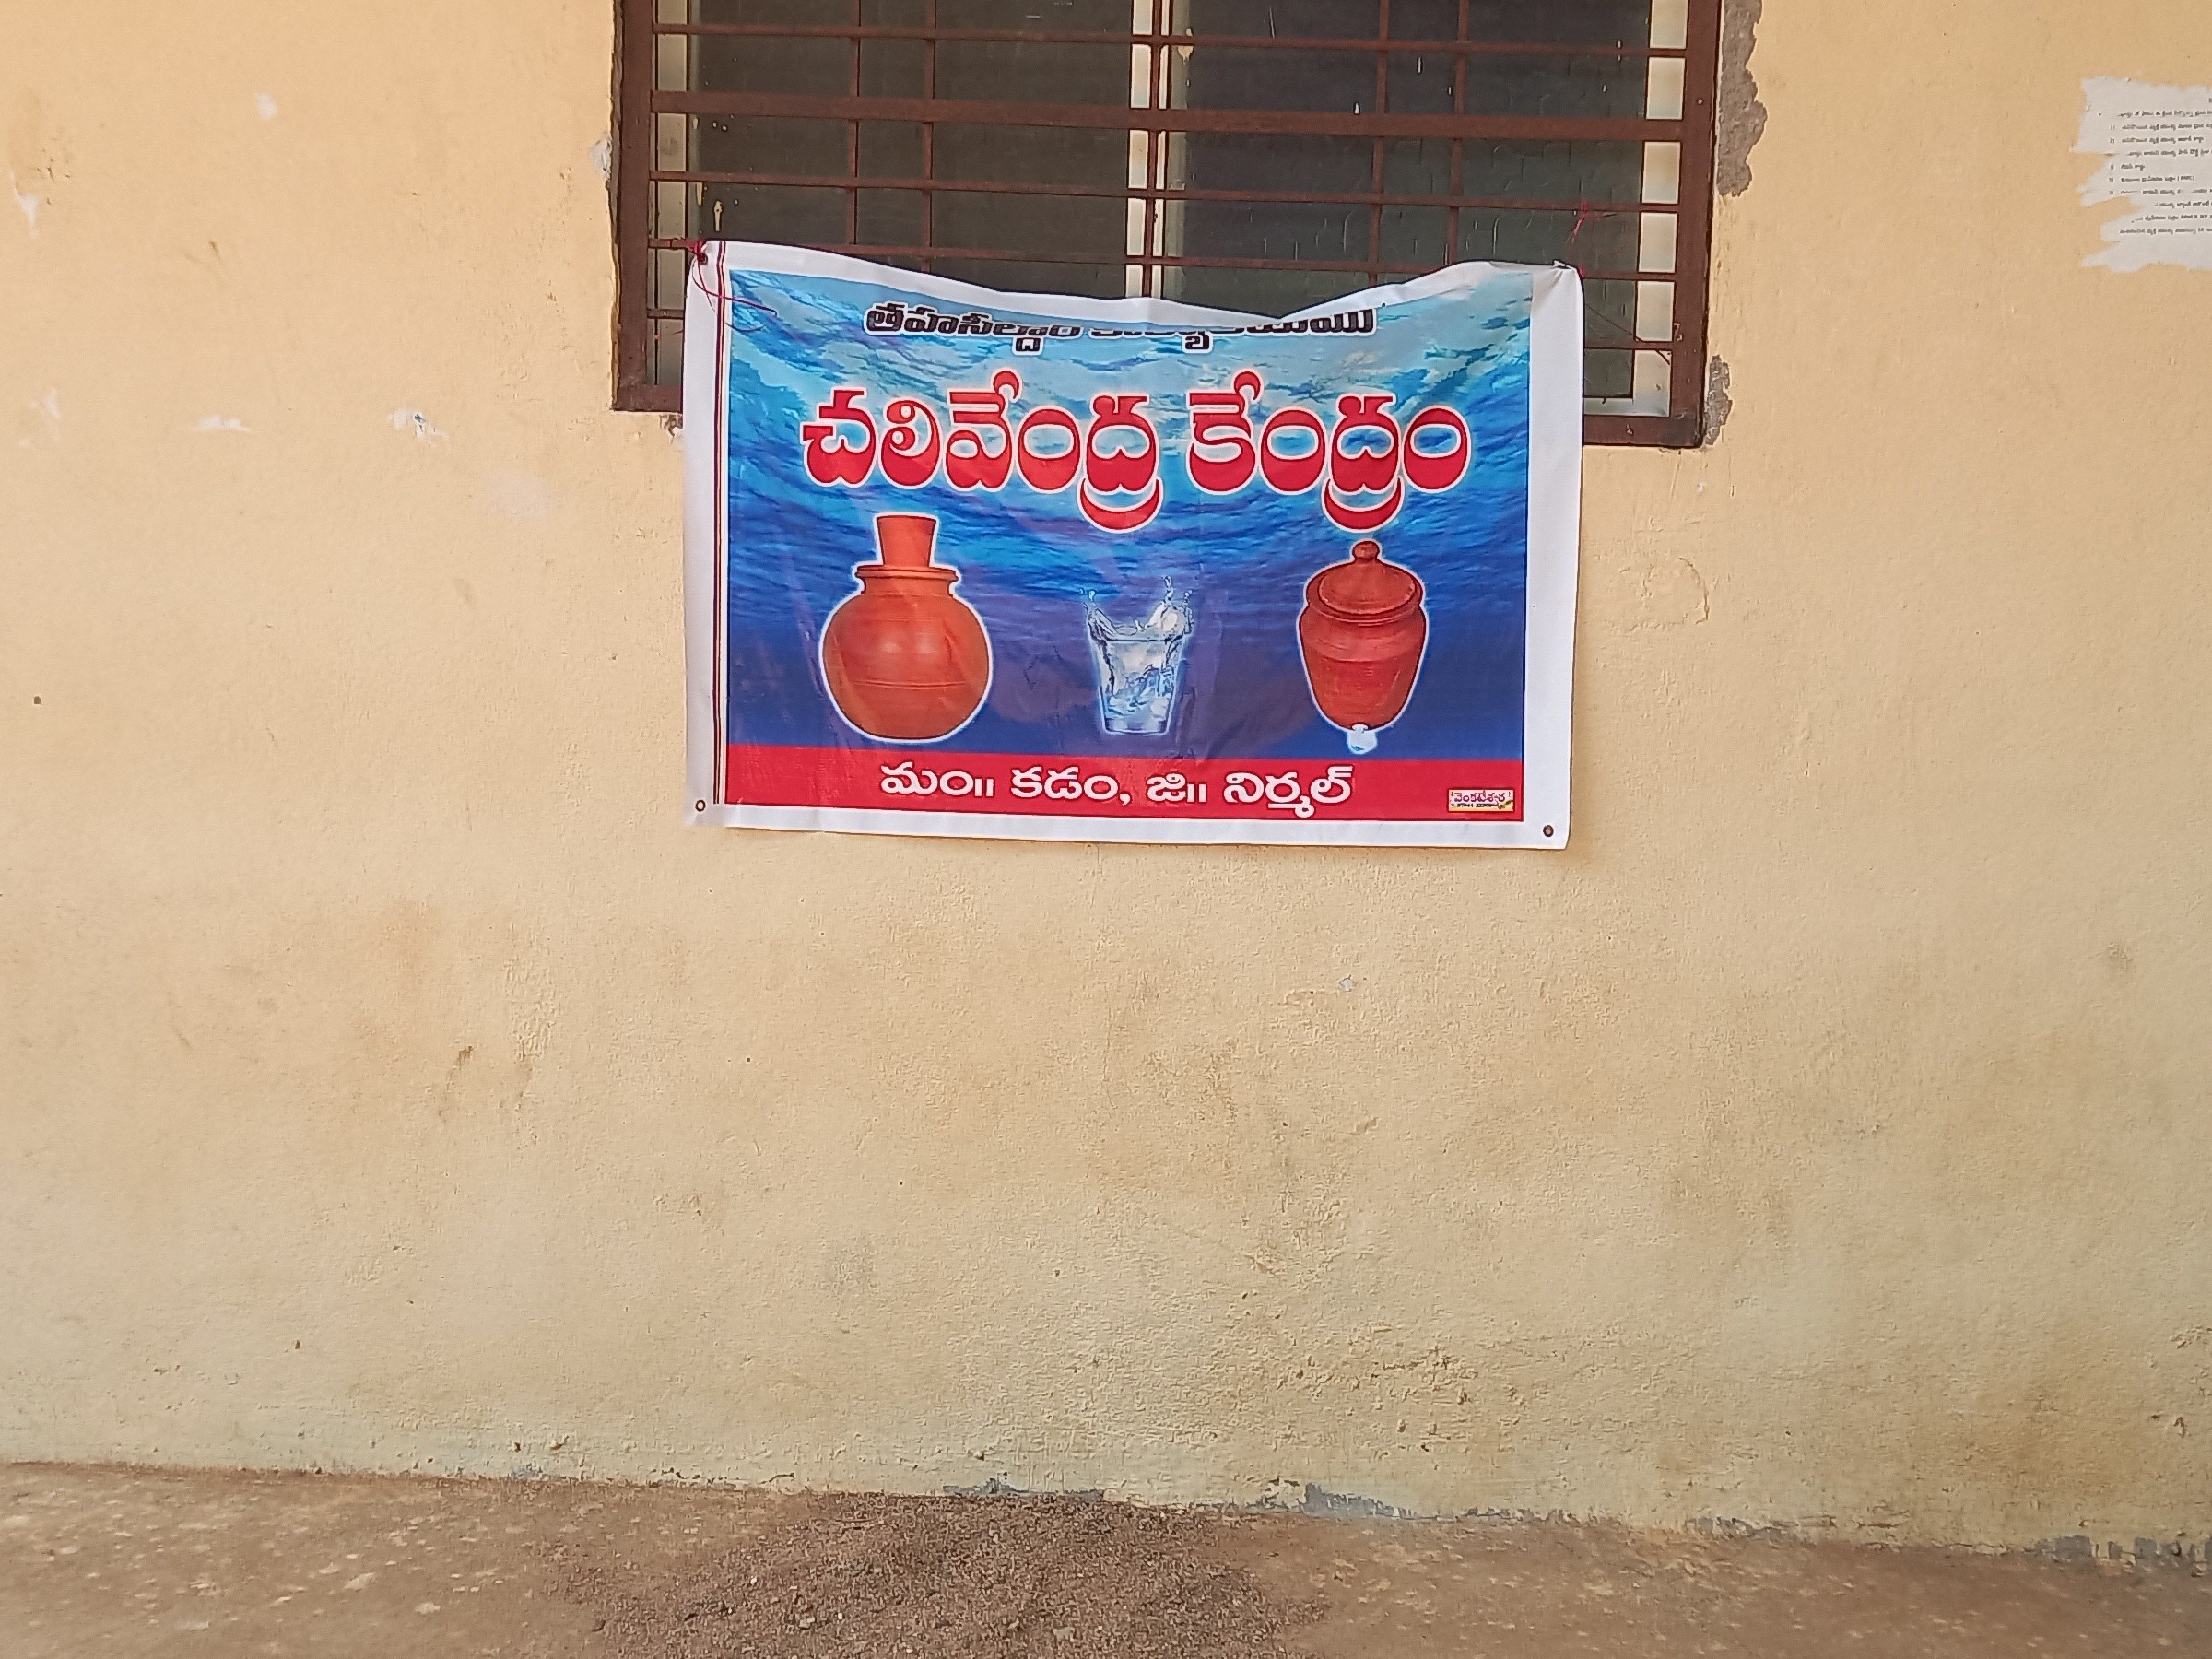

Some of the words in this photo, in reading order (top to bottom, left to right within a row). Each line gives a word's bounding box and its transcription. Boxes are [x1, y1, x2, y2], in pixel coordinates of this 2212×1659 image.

[802, 369, 1163, 533] చలివేంద్ర
[1187, 370, 1472, 534] కేంద్రం
[1010, 765, 1133, 806] కడం,
[1223, 764, 1354, 818] నిర్మల్
